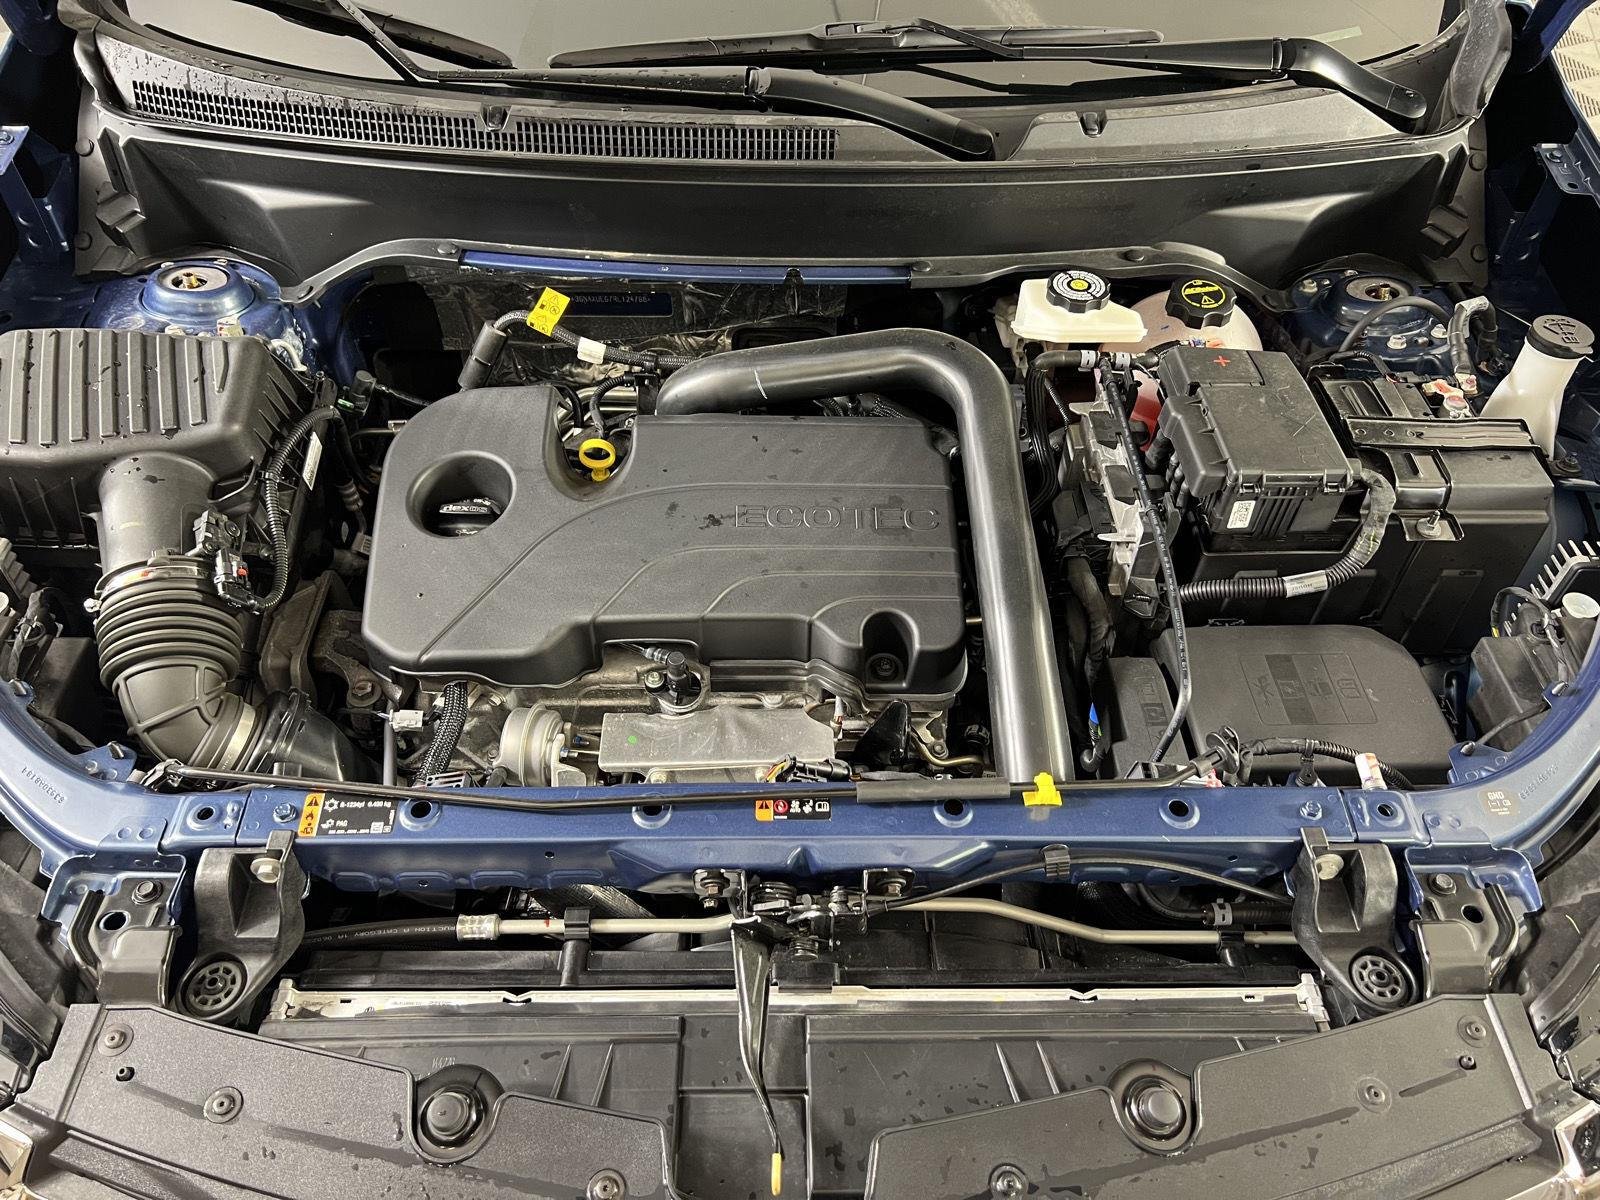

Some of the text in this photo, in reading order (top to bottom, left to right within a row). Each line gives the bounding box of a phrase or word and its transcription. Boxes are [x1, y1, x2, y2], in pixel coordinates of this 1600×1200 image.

[443, 504, 488, 513] dexos
[735, 504, 940, 531] ECOTEC
[336, 819, 348, 827] PAG
[354, 928, 398, 937] CATEGORY
